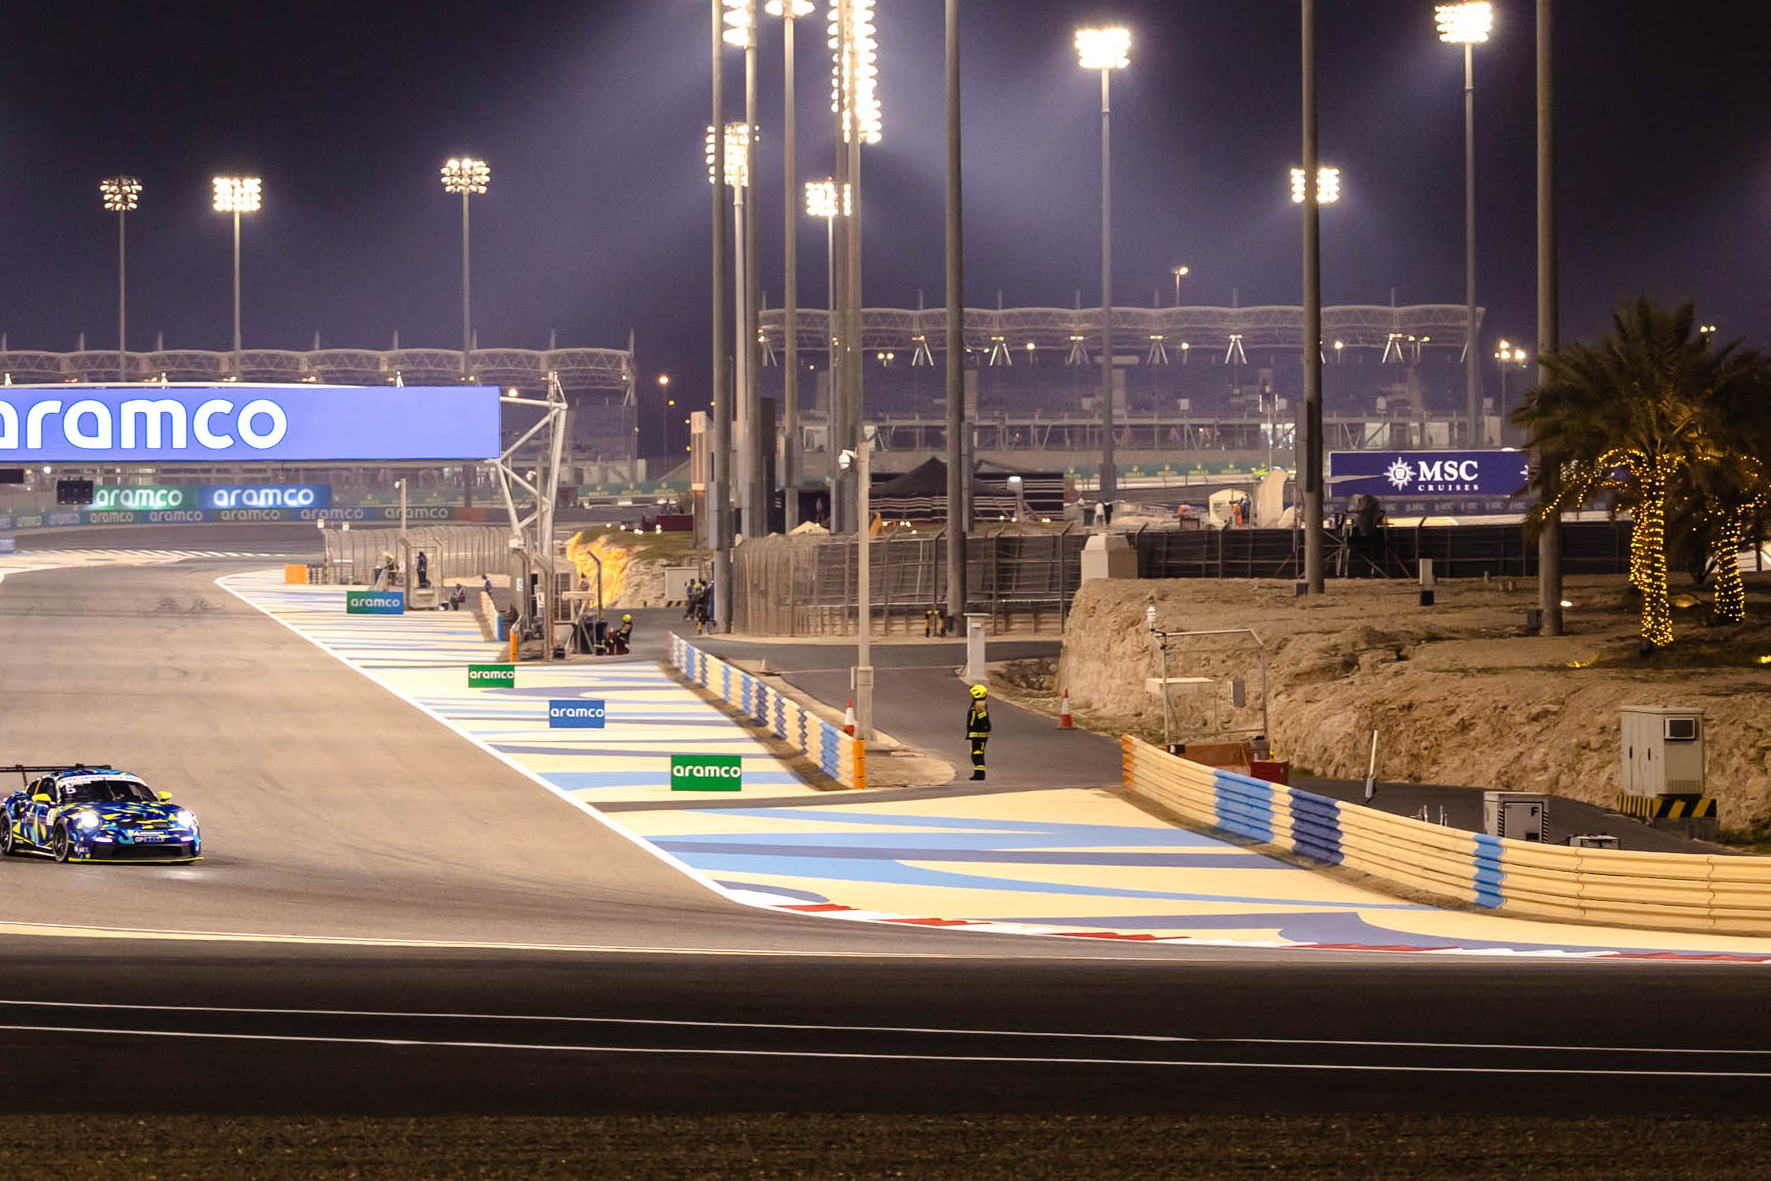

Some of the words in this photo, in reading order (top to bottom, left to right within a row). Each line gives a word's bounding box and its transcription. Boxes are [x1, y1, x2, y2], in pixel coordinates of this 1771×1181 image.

[1418, 460, 1478, 482] MSC
[96, 489, 183, 507] aramco
[213, 488, 314, 507] aramco
[90, 511, 134, 524] aramco
[149, 509, 203, 522] aramco
[221, 509, 280, 521] aramco
[300, 508, 364, 520] aramco
[350, 598, 400, 608] aramco
[469, 670, 515, 679] aramco
[550, 707, 604, 717] aramco
[673, 765, 741, 778] aramco
